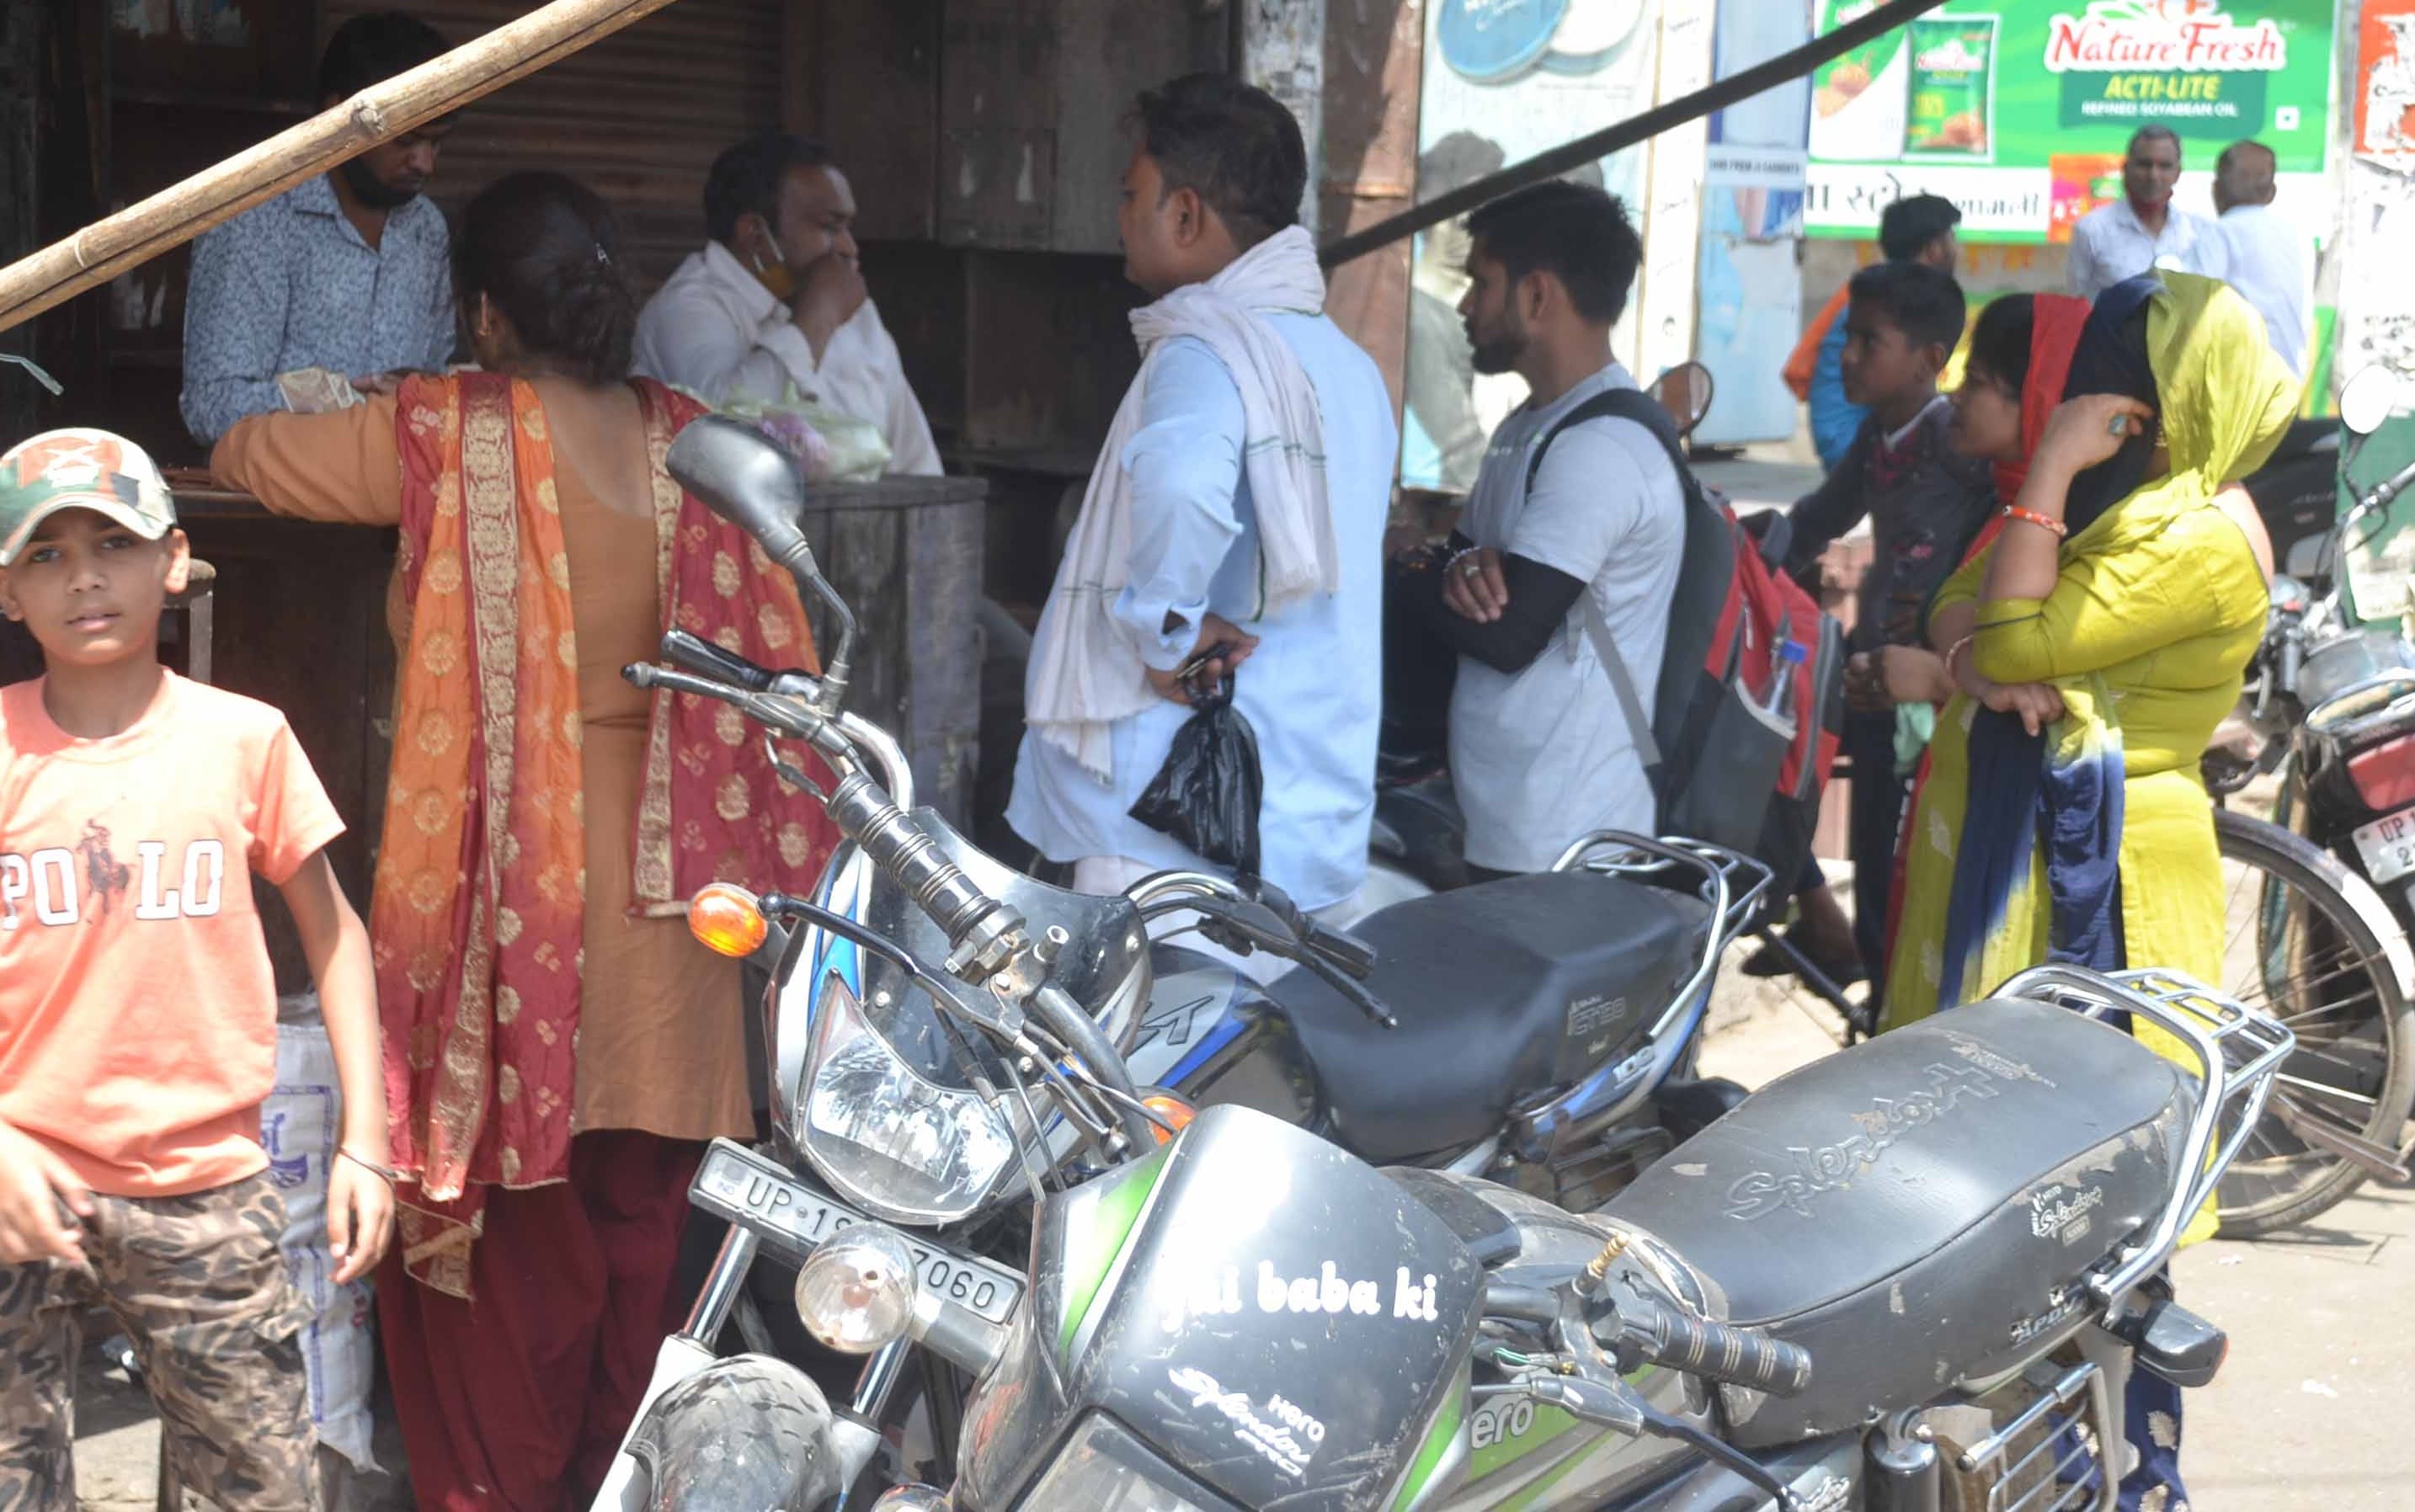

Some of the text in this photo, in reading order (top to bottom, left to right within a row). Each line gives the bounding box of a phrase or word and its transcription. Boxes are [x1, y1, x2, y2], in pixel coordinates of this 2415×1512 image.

[2053, 20, 2278, 63] Nature Fresh
[2104, 74, 2222, 100] ACTI-LITE
[2378, 817, 2404, 844] UP
[745, 1176, 793, 1217] UP
[911, 1248, 997, 1310] 7060
[1256, 1259, 1381, 1315] baba
[1393, 1265, 1438, 1322] ki
[1470, 1397, 1534, 1451] ero
